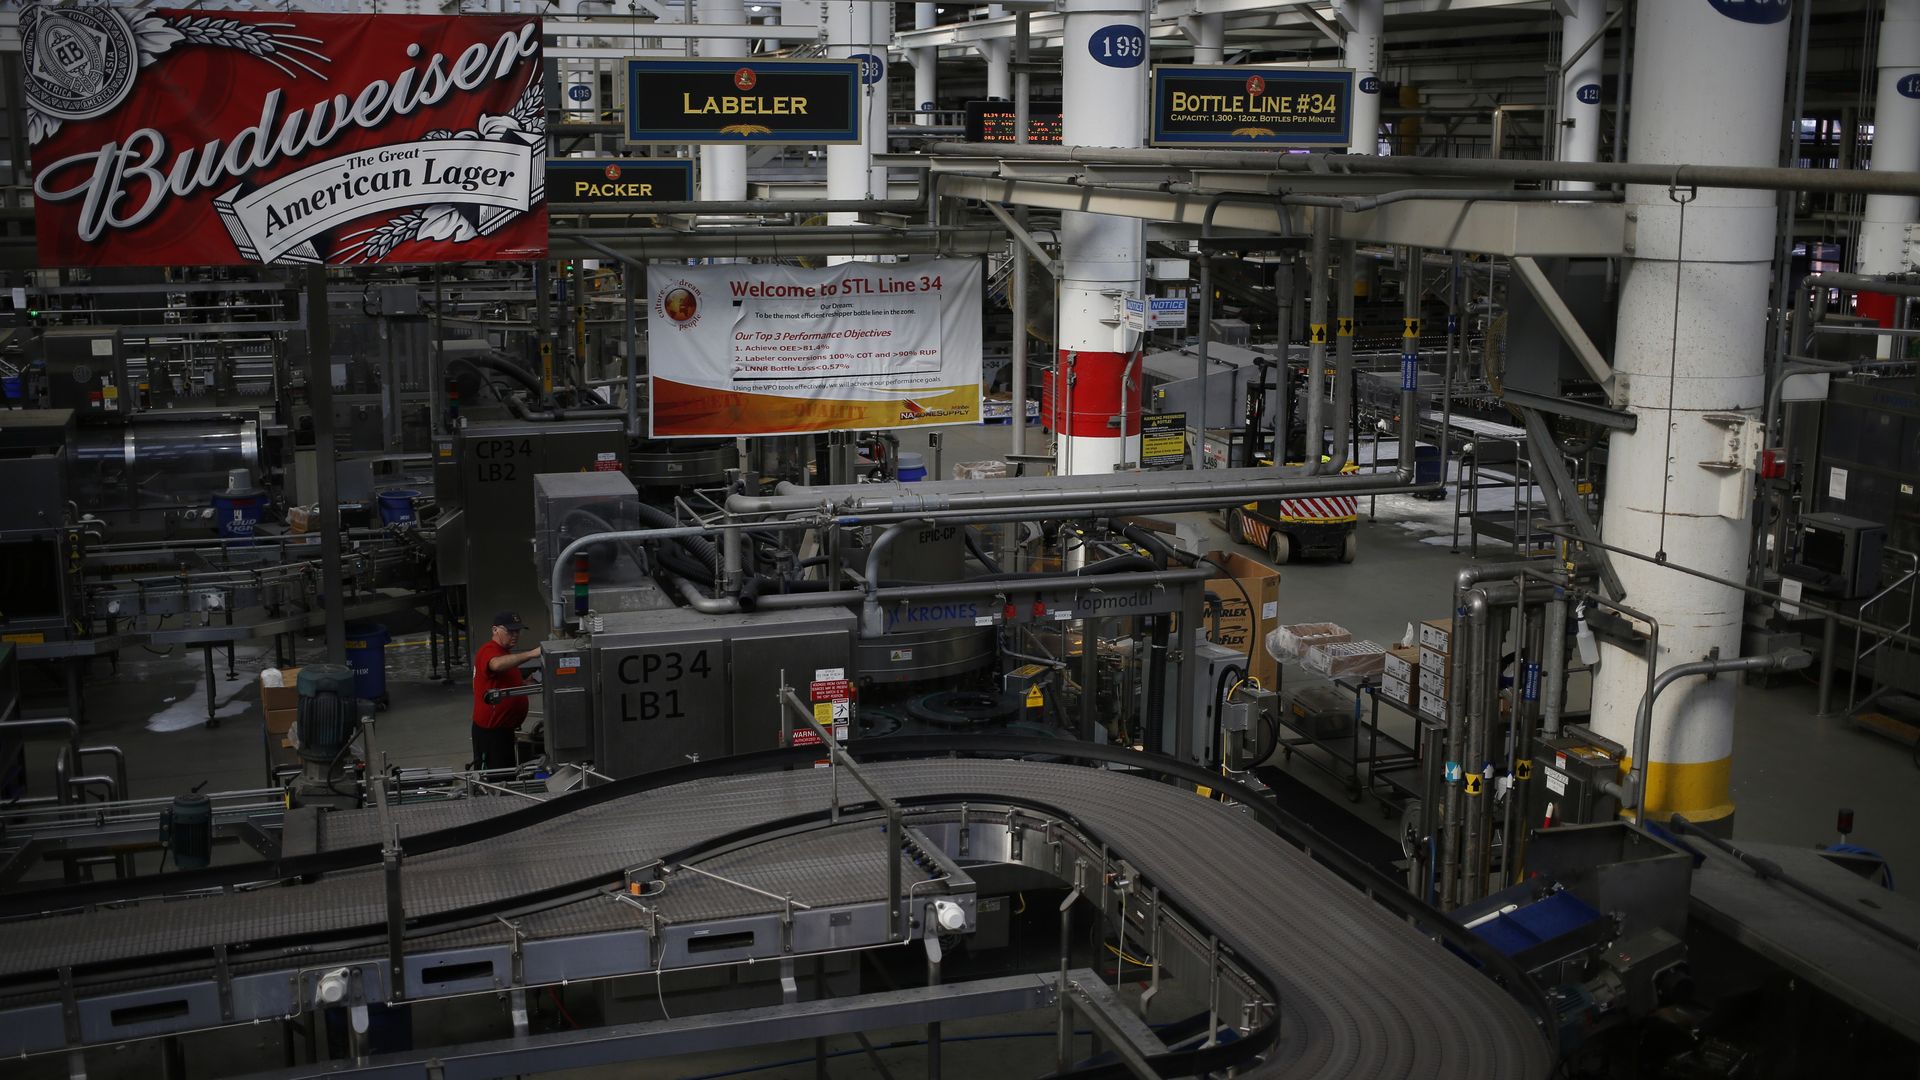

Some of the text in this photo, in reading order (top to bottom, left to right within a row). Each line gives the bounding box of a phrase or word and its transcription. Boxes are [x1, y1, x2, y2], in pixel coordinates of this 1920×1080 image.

[68, 12, 97, 28] EUROPE
[1103, 36, 1142, 57] 199
[105, 51, 115, 74] ASIA
[862, 61, 879, 77] 98
[42, 81, 72, 98] AFRICA
[81, 88, 114, 108] AMERICA
[682, 92, 809, 115] LABELER
[1171, 91, 1336, 114] BOTTLE LINE #34
[1170, 114, 1209, 122] CAPACITY:
[1211, 114, 1232, 123] 1,300
[1259, 115, 1291, 123] BOTTLES
[1308, 116, 1336, 124] MINUTE
[34, 23, 538, 241] Budweiser
[347, 148, 419, 170] The Great
[265, 158, 515, 238] American Lager
[574, 181, 653, 197] PACKER
[679, 279, 701, 296] dream
[730, 276, 943, 298] Welcome to STL Line 34
[654, 289, 665, 318] culture
[1127, 301, 1143, 311] NOTICE
[1152, 301, 1184, 309] NOTICE
[679, 314, 701, 331] people
[801, 311, 825, 319] efficient
[735, 328, 892, 342] Our Top 3 Performance Objectives
[745, 344, 778, 352] Achieve
[777, 354, 827, 362] conversions
[770, 364, 795, 372] Bottle
[733, 384, 752, 392] Using
[778, 383, 794, 391] tools
[850, 380, 873, 388] achieve
[885, 378, 924, 387] performance
[476, 439, 533, 459] CP34
[478, 463, 517, 482] LB2
[1076, 591, 1153, 611] Topmodul
[908, 603, 977, 622] KRONES
[1203, 608, 1247, 617] MRLEX
[618, 650, 711, 684] CP34
[622, 689, 685, 721] LB1
